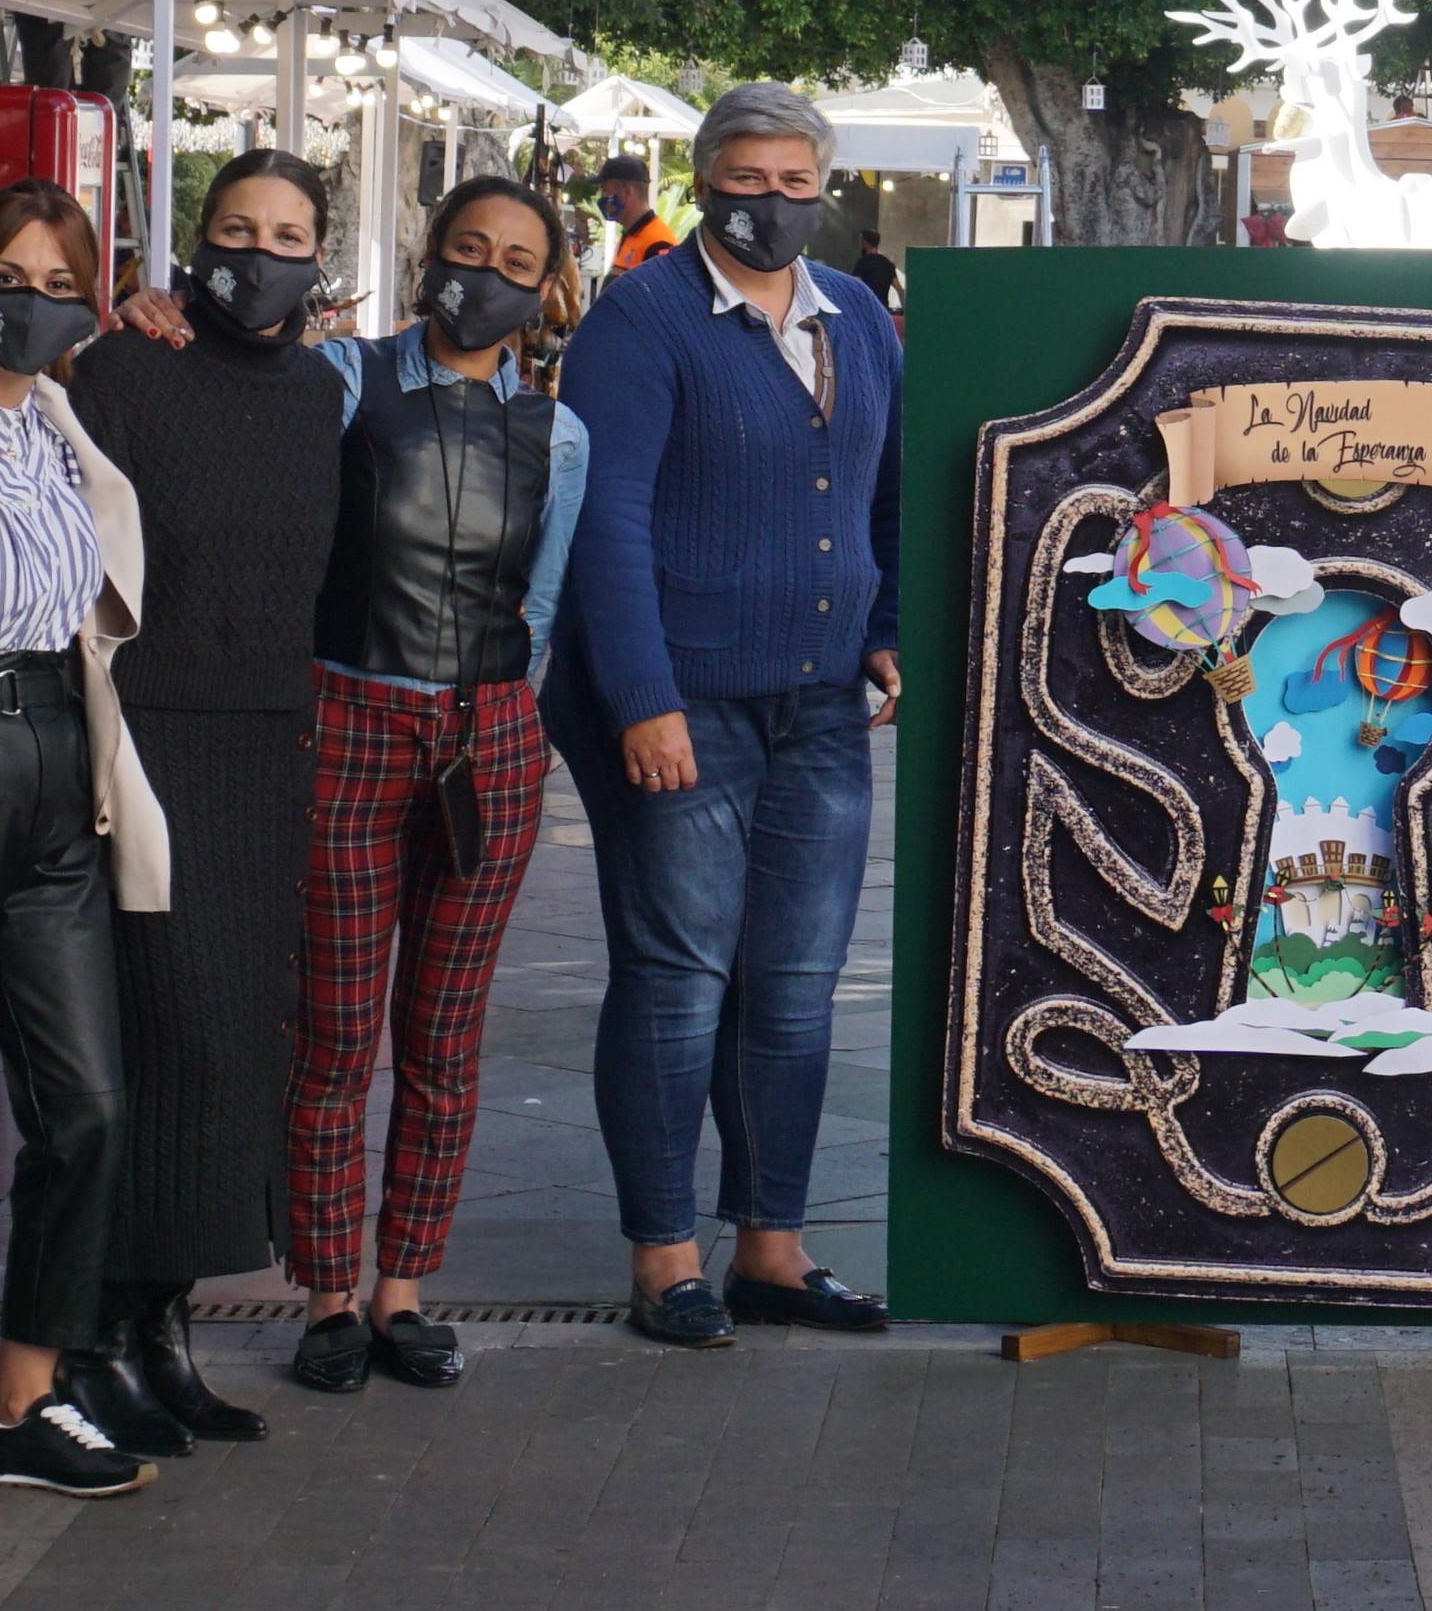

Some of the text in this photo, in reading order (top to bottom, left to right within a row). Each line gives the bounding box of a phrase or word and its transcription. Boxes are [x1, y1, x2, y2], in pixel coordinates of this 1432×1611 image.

[1243, 390, 1373, 436] La Navidad
[1271, 430, 1427, 478] de la Esperanza
